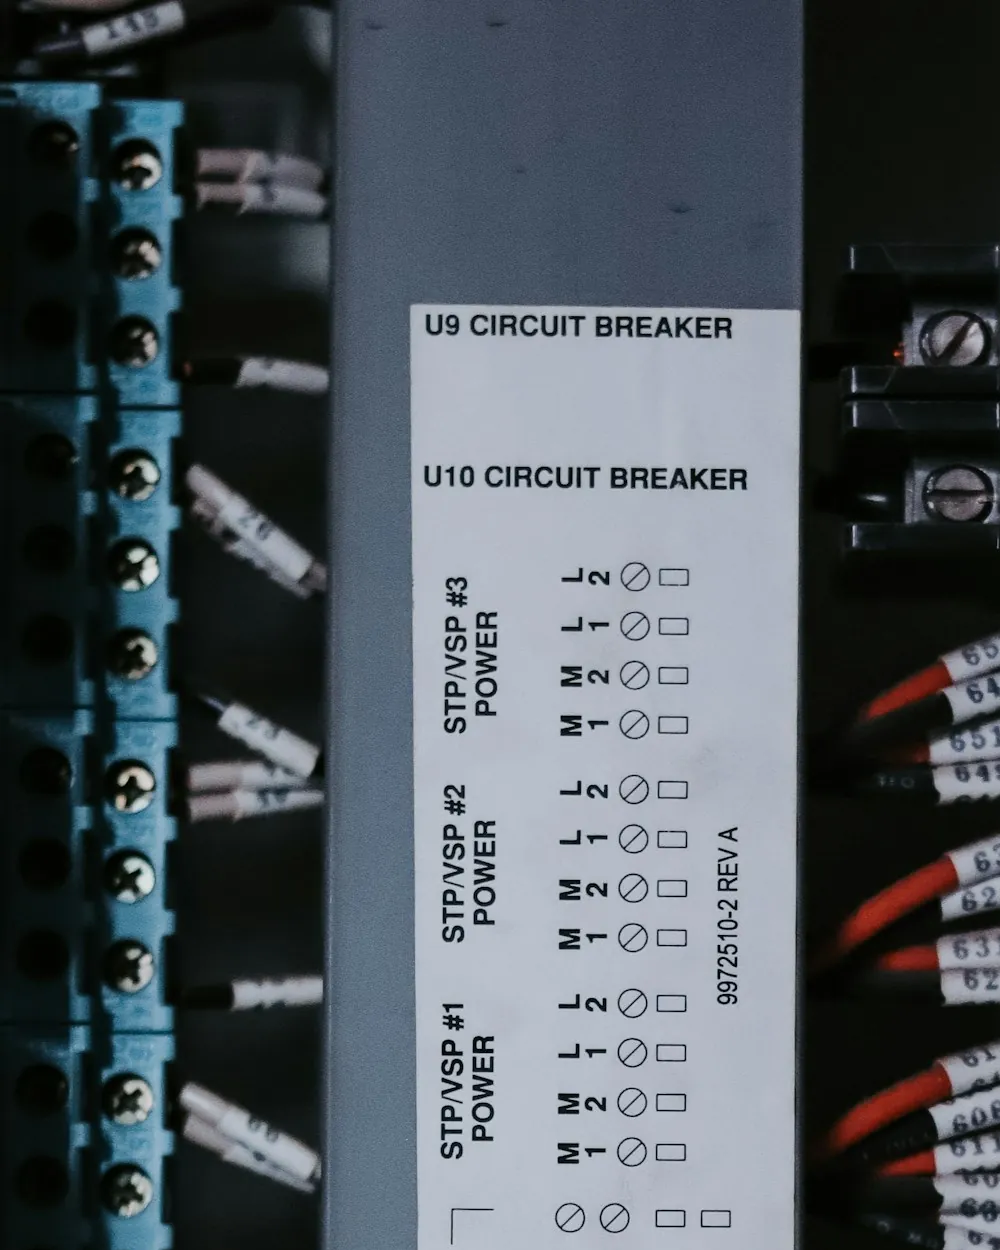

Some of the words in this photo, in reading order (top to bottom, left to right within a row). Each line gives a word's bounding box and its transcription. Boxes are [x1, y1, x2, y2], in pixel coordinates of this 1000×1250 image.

[425, 313, 460, 336] U9
[469, 314, 587, 337] CIRCUIT
[595, 315, 733, 340] BREAKER
[423, 465, 475, 488] U10
[484, 465, 601, 489] CIRCUIT
[610, 467, 748, 491] BREAKER
[561, 567, 584, 583] L
[587, 570, 610, 586] 2
[445, 576, 468, 608] #3
[560, 616, 583, 632] L
[587, 621, 610, 632] 1
[443, 615, 468, 734] STP/VSP
[474, 611, 498, 717] POWER
[560, 665, 583, 688] M
[587, 669, 610, 685] 2
[559, 714, 583, 737] M
[587, 720, 609, 730] 1
[443, 784, 466, 816] #2
[559, 780, 582, 796] L
[586, 784, 609, 799] 2
[559, 829, 582, 846] L
[586, 834, 608, 845] 1
[717, 826, 739, 843] A
[472, 820, 496, 926] POWER
[717, 849, 739, 892] REV
[441, 823, 466, 944] STP/VSP
[558, 879, 581, 901] M
[585, 882, 608, 898] 2
[558, 928, 581, 950] M
[585, 933, 608, 944] 1
[716, 899, 739, 1006] 9972510-2
[557, 993, 581, 1010] L
[584, 997, 607, 1013] 2
[441, 1003, 465, 1032] #1
[557, 1043, 581, 1059] L
[584, 1048, 607, 1059] 1
[440, 1039, 464, 1160] STP/VSP
[471, 1035, 495, 1142] POWER
[557, 1092, 580, 1115] M
[584, 1096, 607, 1112] 2
[557, 1142, 580, 1165] M
[584, 1147, 607, 1158] 1
